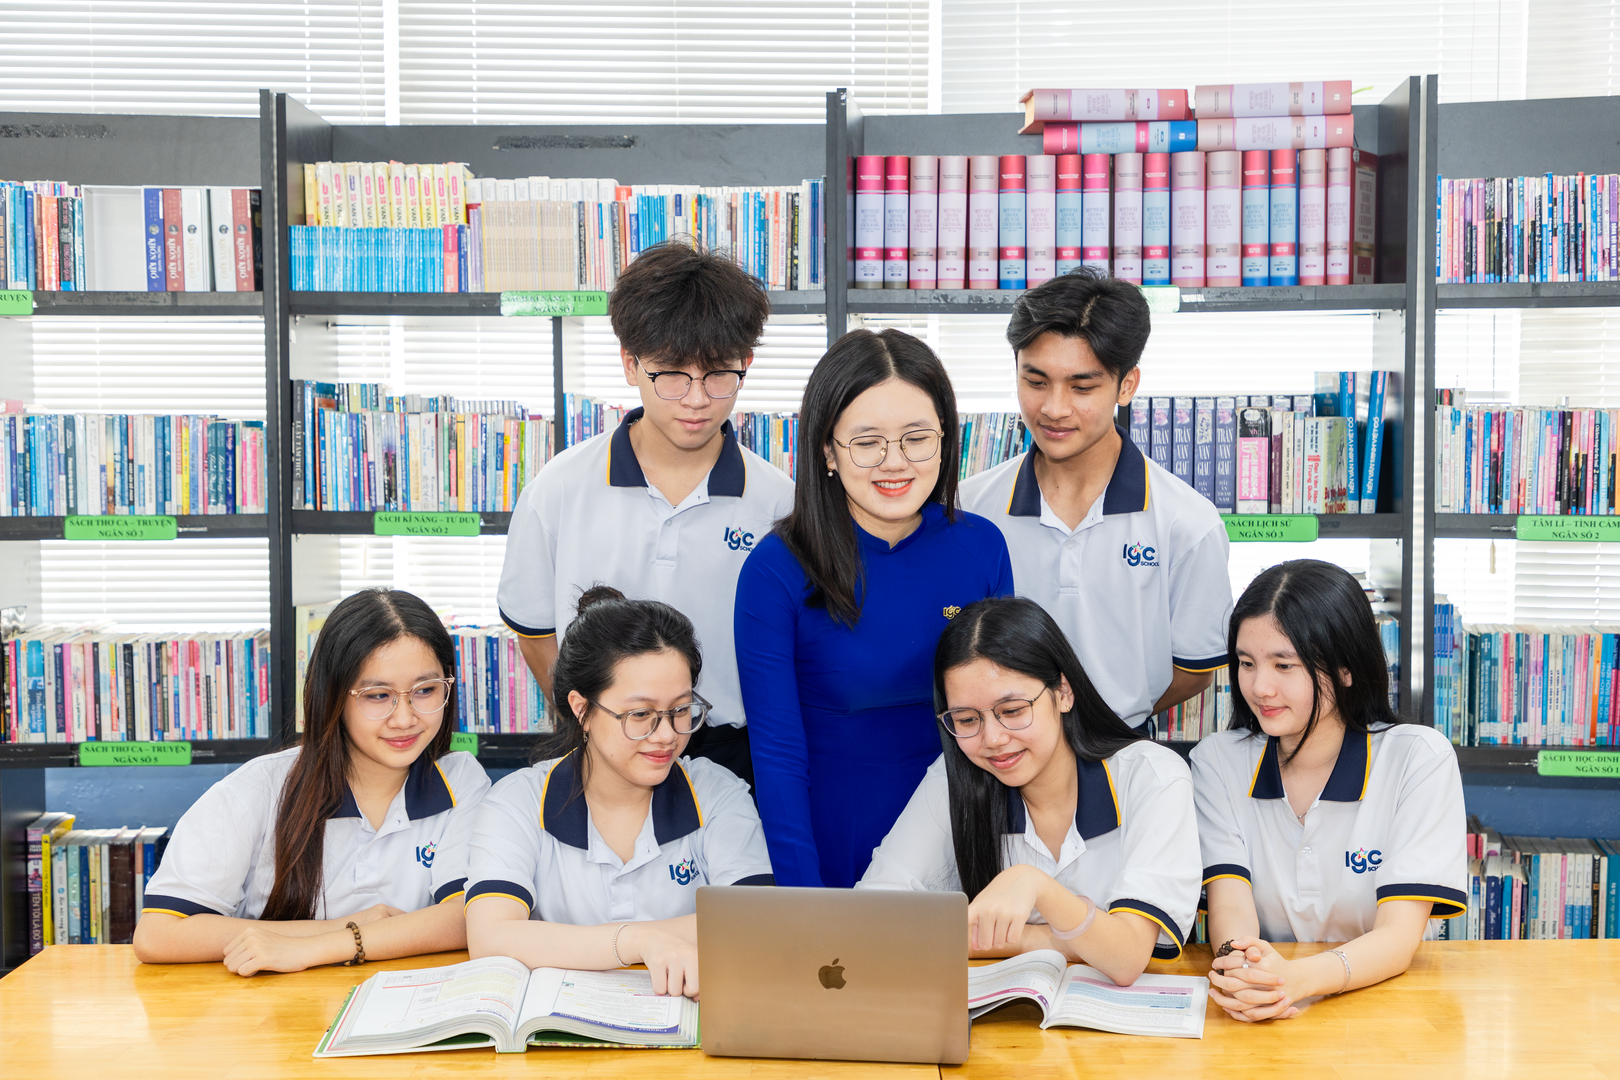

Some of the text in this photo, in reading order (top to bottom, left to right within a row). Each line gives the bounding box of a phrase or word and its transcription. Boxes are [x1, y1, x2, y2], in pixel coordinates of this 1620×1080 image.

[1346, 416, 1354, 428] CỔ
[1372, 416, 1380, 428] CỔ
[1132, 426, 1148, 443] TRẦN
[1153, 428, 1169, 444] TRẦN
[1175, 426, 1191, 443] TRẦN
[1217, 426, 1233, 443] TRẦN
[1371, 428, 1379, 445] VIỆT
[295, 420, 303, 478] LUẬT TÂM THỨC
[1155, 445, 1167, 460] VĂN
[1177, 444, 1188, 459] VĂN
[1199, 444, 1210, 459] VĂN
[1219, 444, 1231, 459] VĂN
[1241, 440, 1258, 453] 10
[1369, 444, 1377, 463] MINH
[1176, 460, 1189, 475] GIÀU
[1198, 461, 1211, 476] GIÀU
[1218, 460, 1232, 476] GIÀU
[1241, 454, 1252, 497] TRUNG QUỐC
[69, 517, 93, 526] SÁCH
[94, 517, 115, 526] THƠ
[116, 518, 128, 526] CA
[137, 517, 173, 528] TRUYỆN
[378, 515, 402, 523] SÁCH
[414, 515, 438, 524] NĂNG
[446, 516, 458, 524] TƯ
[459, 516, 475, 524] DUY
[1231, 517, 1293, 529] SÁCH LỊCH SỬ
[1532, 518, 1553, 527] TÂM
[1573, 518, 1597, 528] TÌNH
[99, 529, 121, 538] NGĂN
[125, 528, 138, 538] SỐ
[406, 526, 430, 534] NGĂN
[432, 526, 444, 534] SỐ
[1239, 529, 1263, 538] NGĂN
[1266, 529, 1278, 538] SỐ
[1552, 530, 1578, 539] NGĂN
[1580, 529, 1593, 539] SỐ
[84, 744, 109, 753] SÁCH
[110, 745, 131, 753] THƠ
[150, 745, 186, 755] TRUYỆN
[113, 755, 138, 764] NGĂN
[140, 755, 152, 764] SỐ
[1543, 754, 1566, 762] SÁCH
[1576, 764, 1599, 773] NGĂN
[1601, 764, 1614, 773] SỐ
[32, 893, 42, 940] TÊN TÔI LÀ ĐỎ
